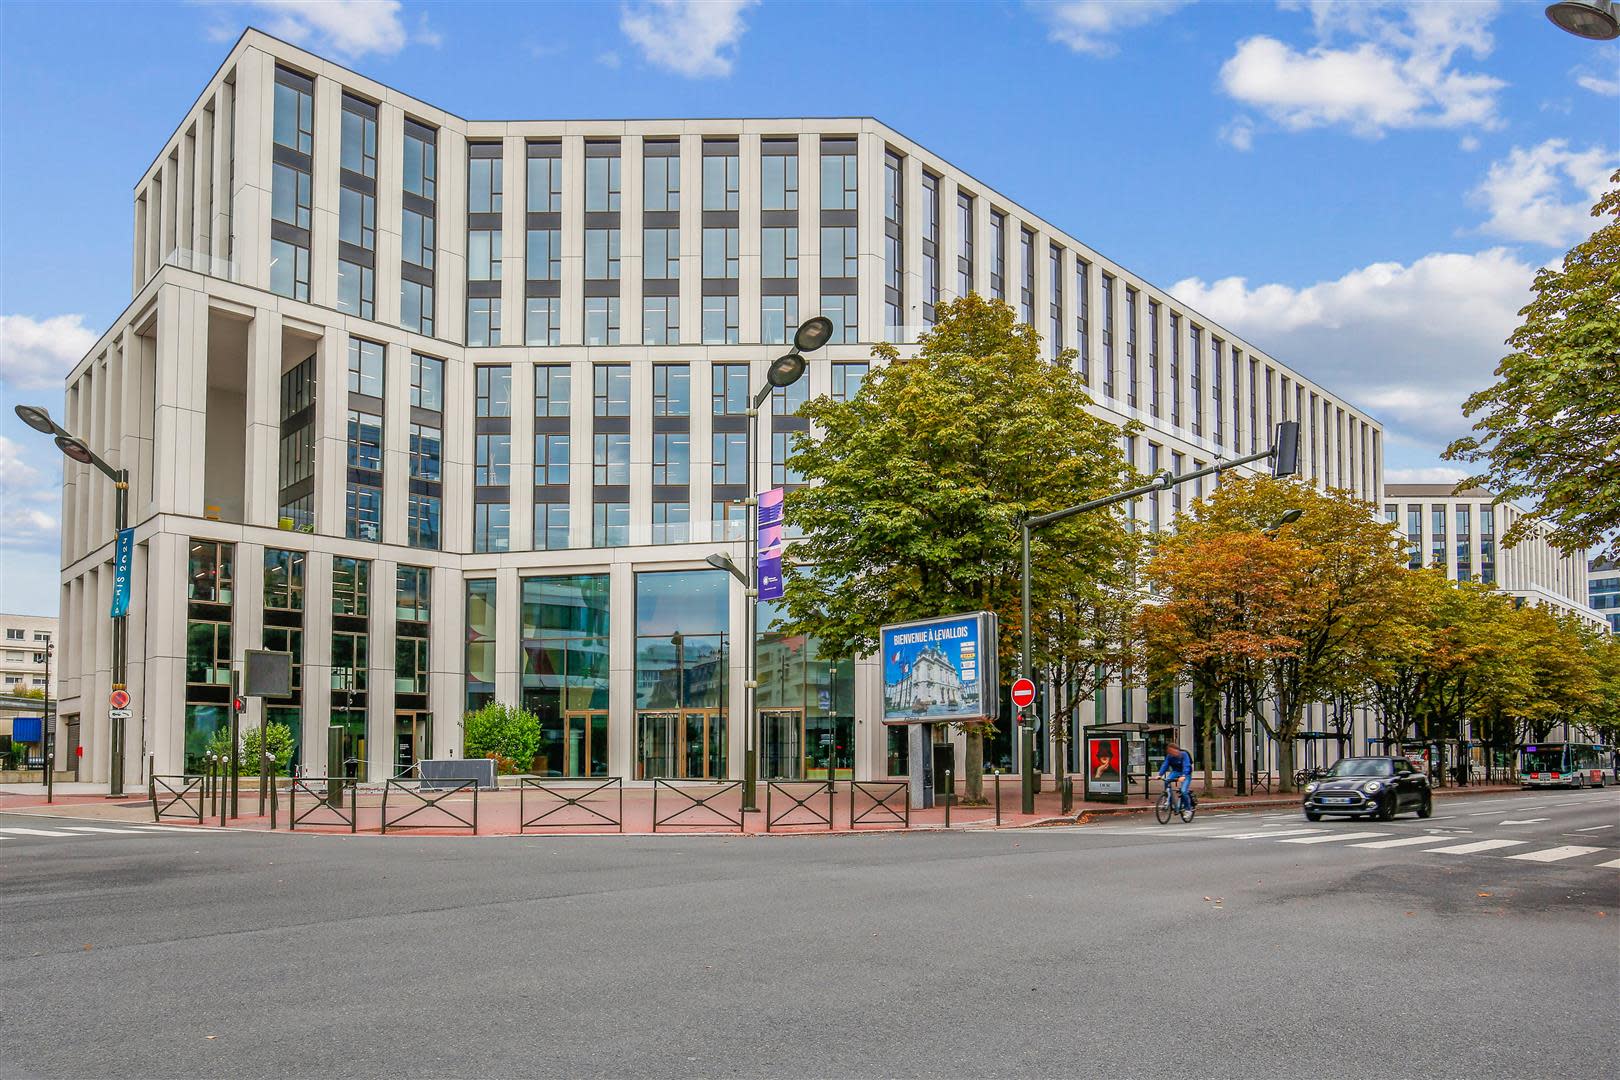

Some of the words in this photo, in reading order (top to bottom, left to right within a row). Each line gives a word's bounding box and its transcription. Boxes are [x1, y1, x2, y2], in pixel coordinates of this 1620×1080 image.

[120, 538, 128, 572] 2024
[894, 632, 928, 646] BIENVENUE
[928, 628, 934, 642] À
[934, 626, 968, 640] LEVALLOIS
